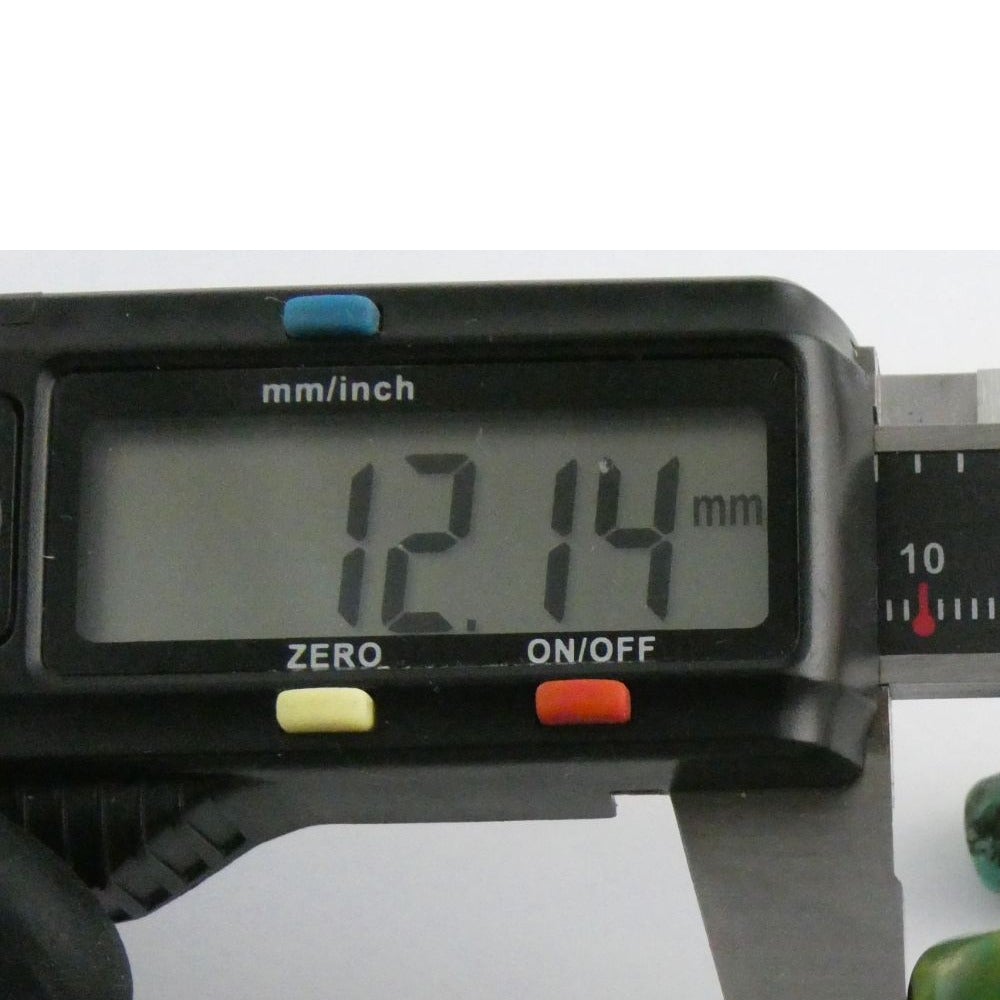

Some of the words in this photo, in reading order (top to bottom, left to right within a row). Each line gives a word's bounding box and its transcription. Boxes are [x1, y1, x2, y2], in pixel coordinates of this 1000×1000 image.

[262, 374, 415, 403] mm/inch
[338, 452, 680, 634] 12.14
[692, 493, 764, 528] mm
[900, 542, 946, 575] 10
[286, 641, 383, 670] ZERO
[526, 635, 657, 665] ON/OFF
